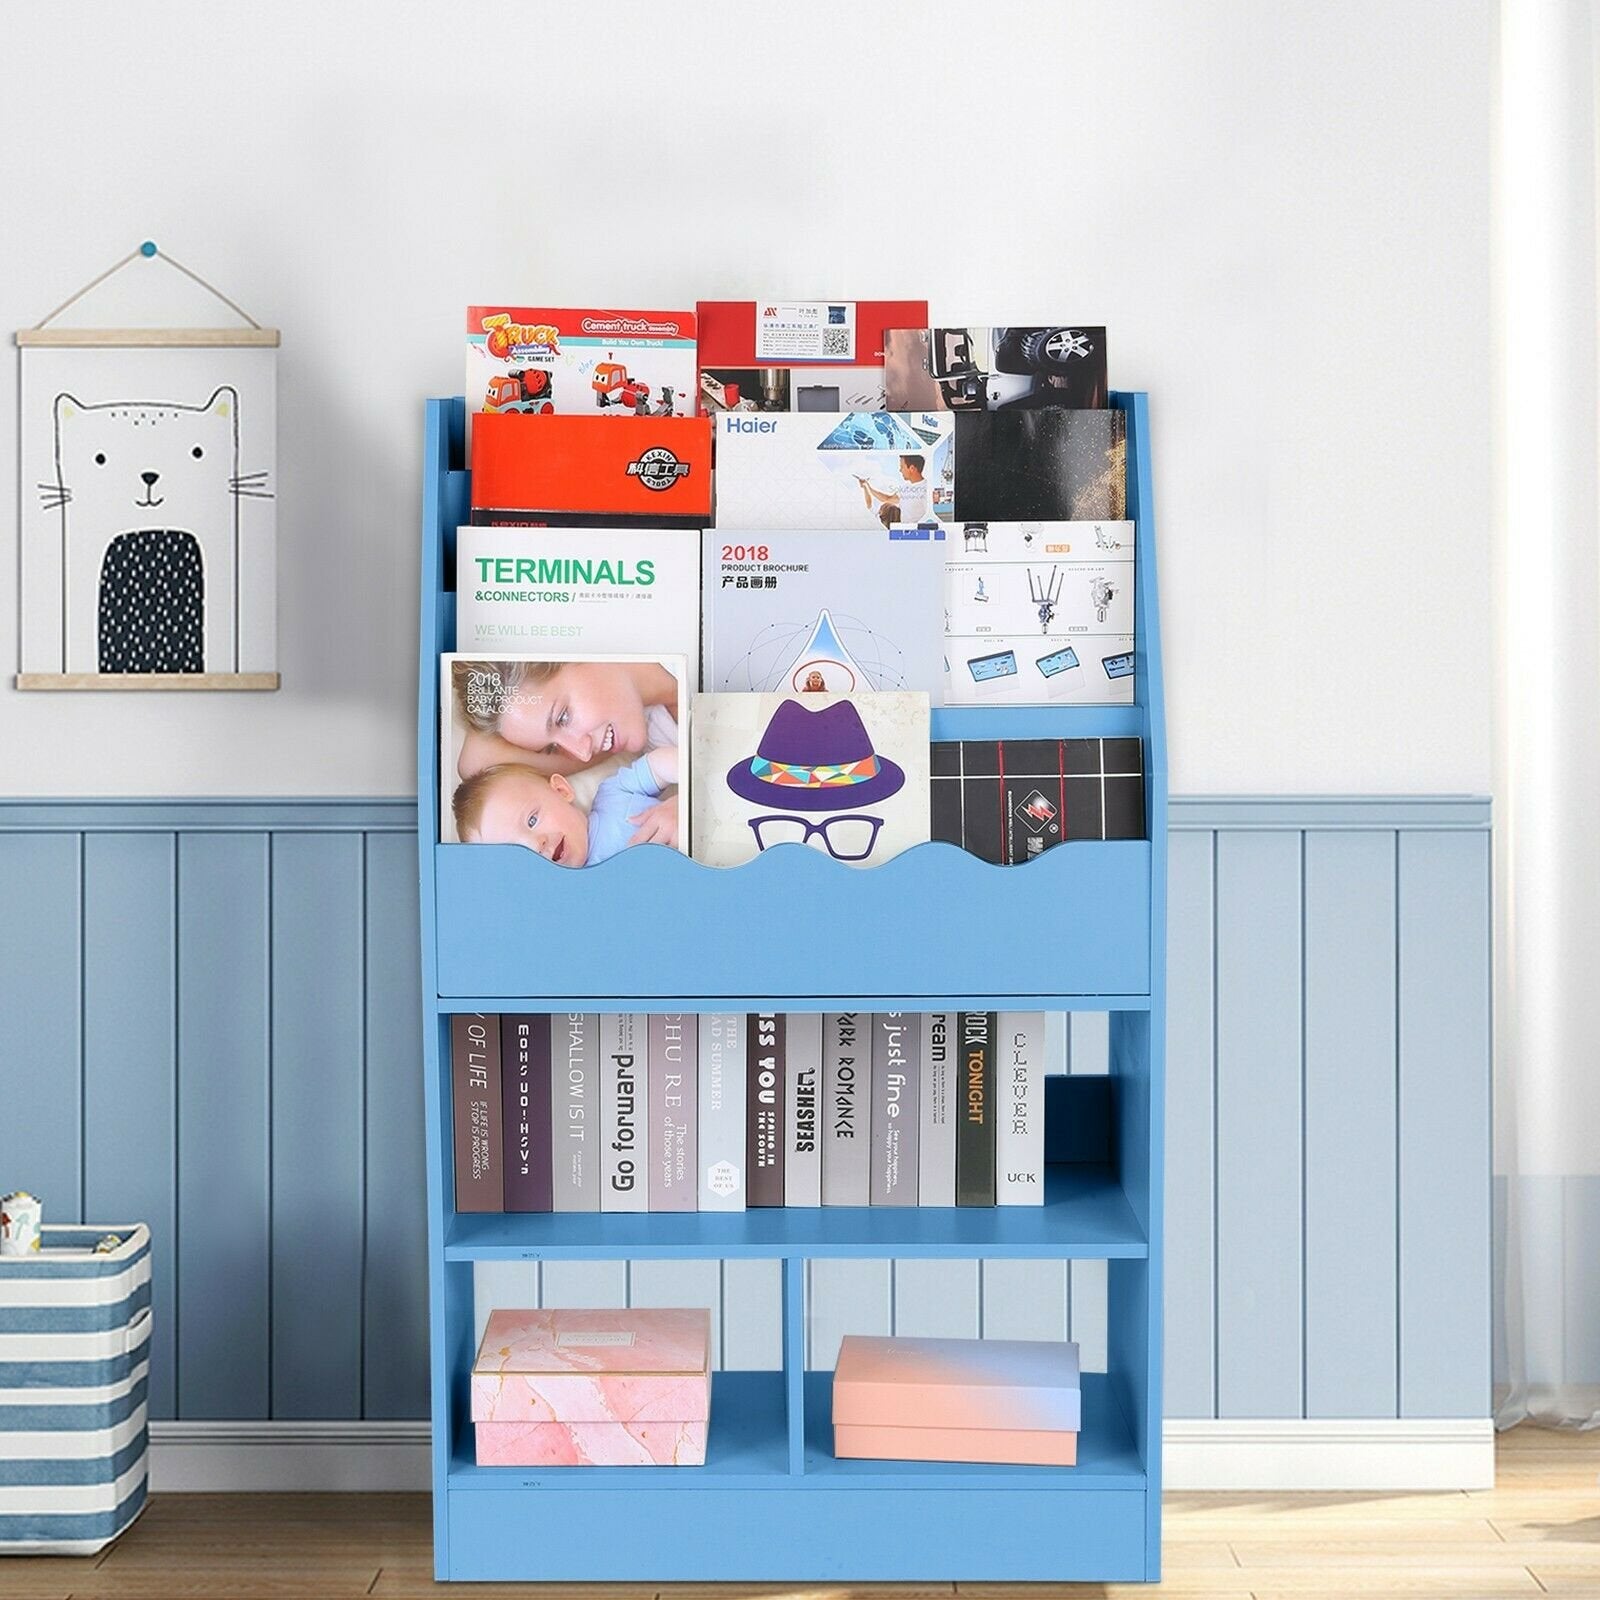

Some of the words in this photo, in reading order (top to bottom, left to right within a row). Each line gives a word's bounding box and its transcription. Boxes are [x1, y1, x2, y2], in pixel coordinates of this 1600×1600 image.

[483, 314, 559, 348] TRUCK
[584, 320, 621, 332] Cement
[623, 320, 647, 332] truck
[527, 355, 543, 363] GAME
[726, 417, 778, 434] Haier
[721, 545, 769, 561] 2018
[474, 557, 656, 586] TERMINALS
[721, 563, 761, 573] PRODUCT
[762, 563, 810, 573] BROCHURE
[721, 575, 778, 590] 产品画册
[474, 590, 570, 603] &CONNECTORS
[474, 624, 495, 636] WE
[497, 624, 528, 637] WILL
[530, 624, 549, 637] BE
[550, 625, 584, 637] BEST
[467, 672, 501, 687] 2018
[467, 685, 520, 696] BRILLANTE
[467, 695, 494, 705] BABY
[495, 695, 544, 705] PRODUCT
[467, 704, 514, 714] CATALOG
[467, 1024, 486, 1049] OF
[726, 1016, 737, 1049] THE
[883, 1022, 908, 1067] just
[931, 1014, 947, 1062] ream
[568, 1012, 584, 1099] SHALLOW
[468, 1055, 488, 1090] LIFE
[711, 1042, 722, 1111] SUMMER
[758, 1056, 776, 1104] YOU
[1011, 1032, 1029, 1135] CLEVER
[664, 1072, 683, 1108] RE
[834, 1057, 856, 1139] ROMANCE
[887, 1073, 907, 1119] fine
[968, 1049, 984, 1125] TONIGHT
[470, 1100, 479, 1124] STOP
[568, 1104, 585, 1120] IS
[611, 1054, 635, 1152] forward
[471, 1125, 480, 1134] IS
[480, 1110, 488, 1127] LIFE
[664, 1116, 675, 1129] of
[480, 1129, 489, 1137] IS
[568, 1124, 585, 1142] IT
[664, 1130, 675, 1157] those
[676, 1123, 687, 1145] The
[472, 1135, 482, 1180] PROGRESS
[481, 1139, 490, 1171] WRONG
[675, 1147, 686, 1181] stories
[611, 1159, 635, 1192] Go
[662, 1158, 673, 1188] years
[1007, 1172, 1037, 1183] UCK
